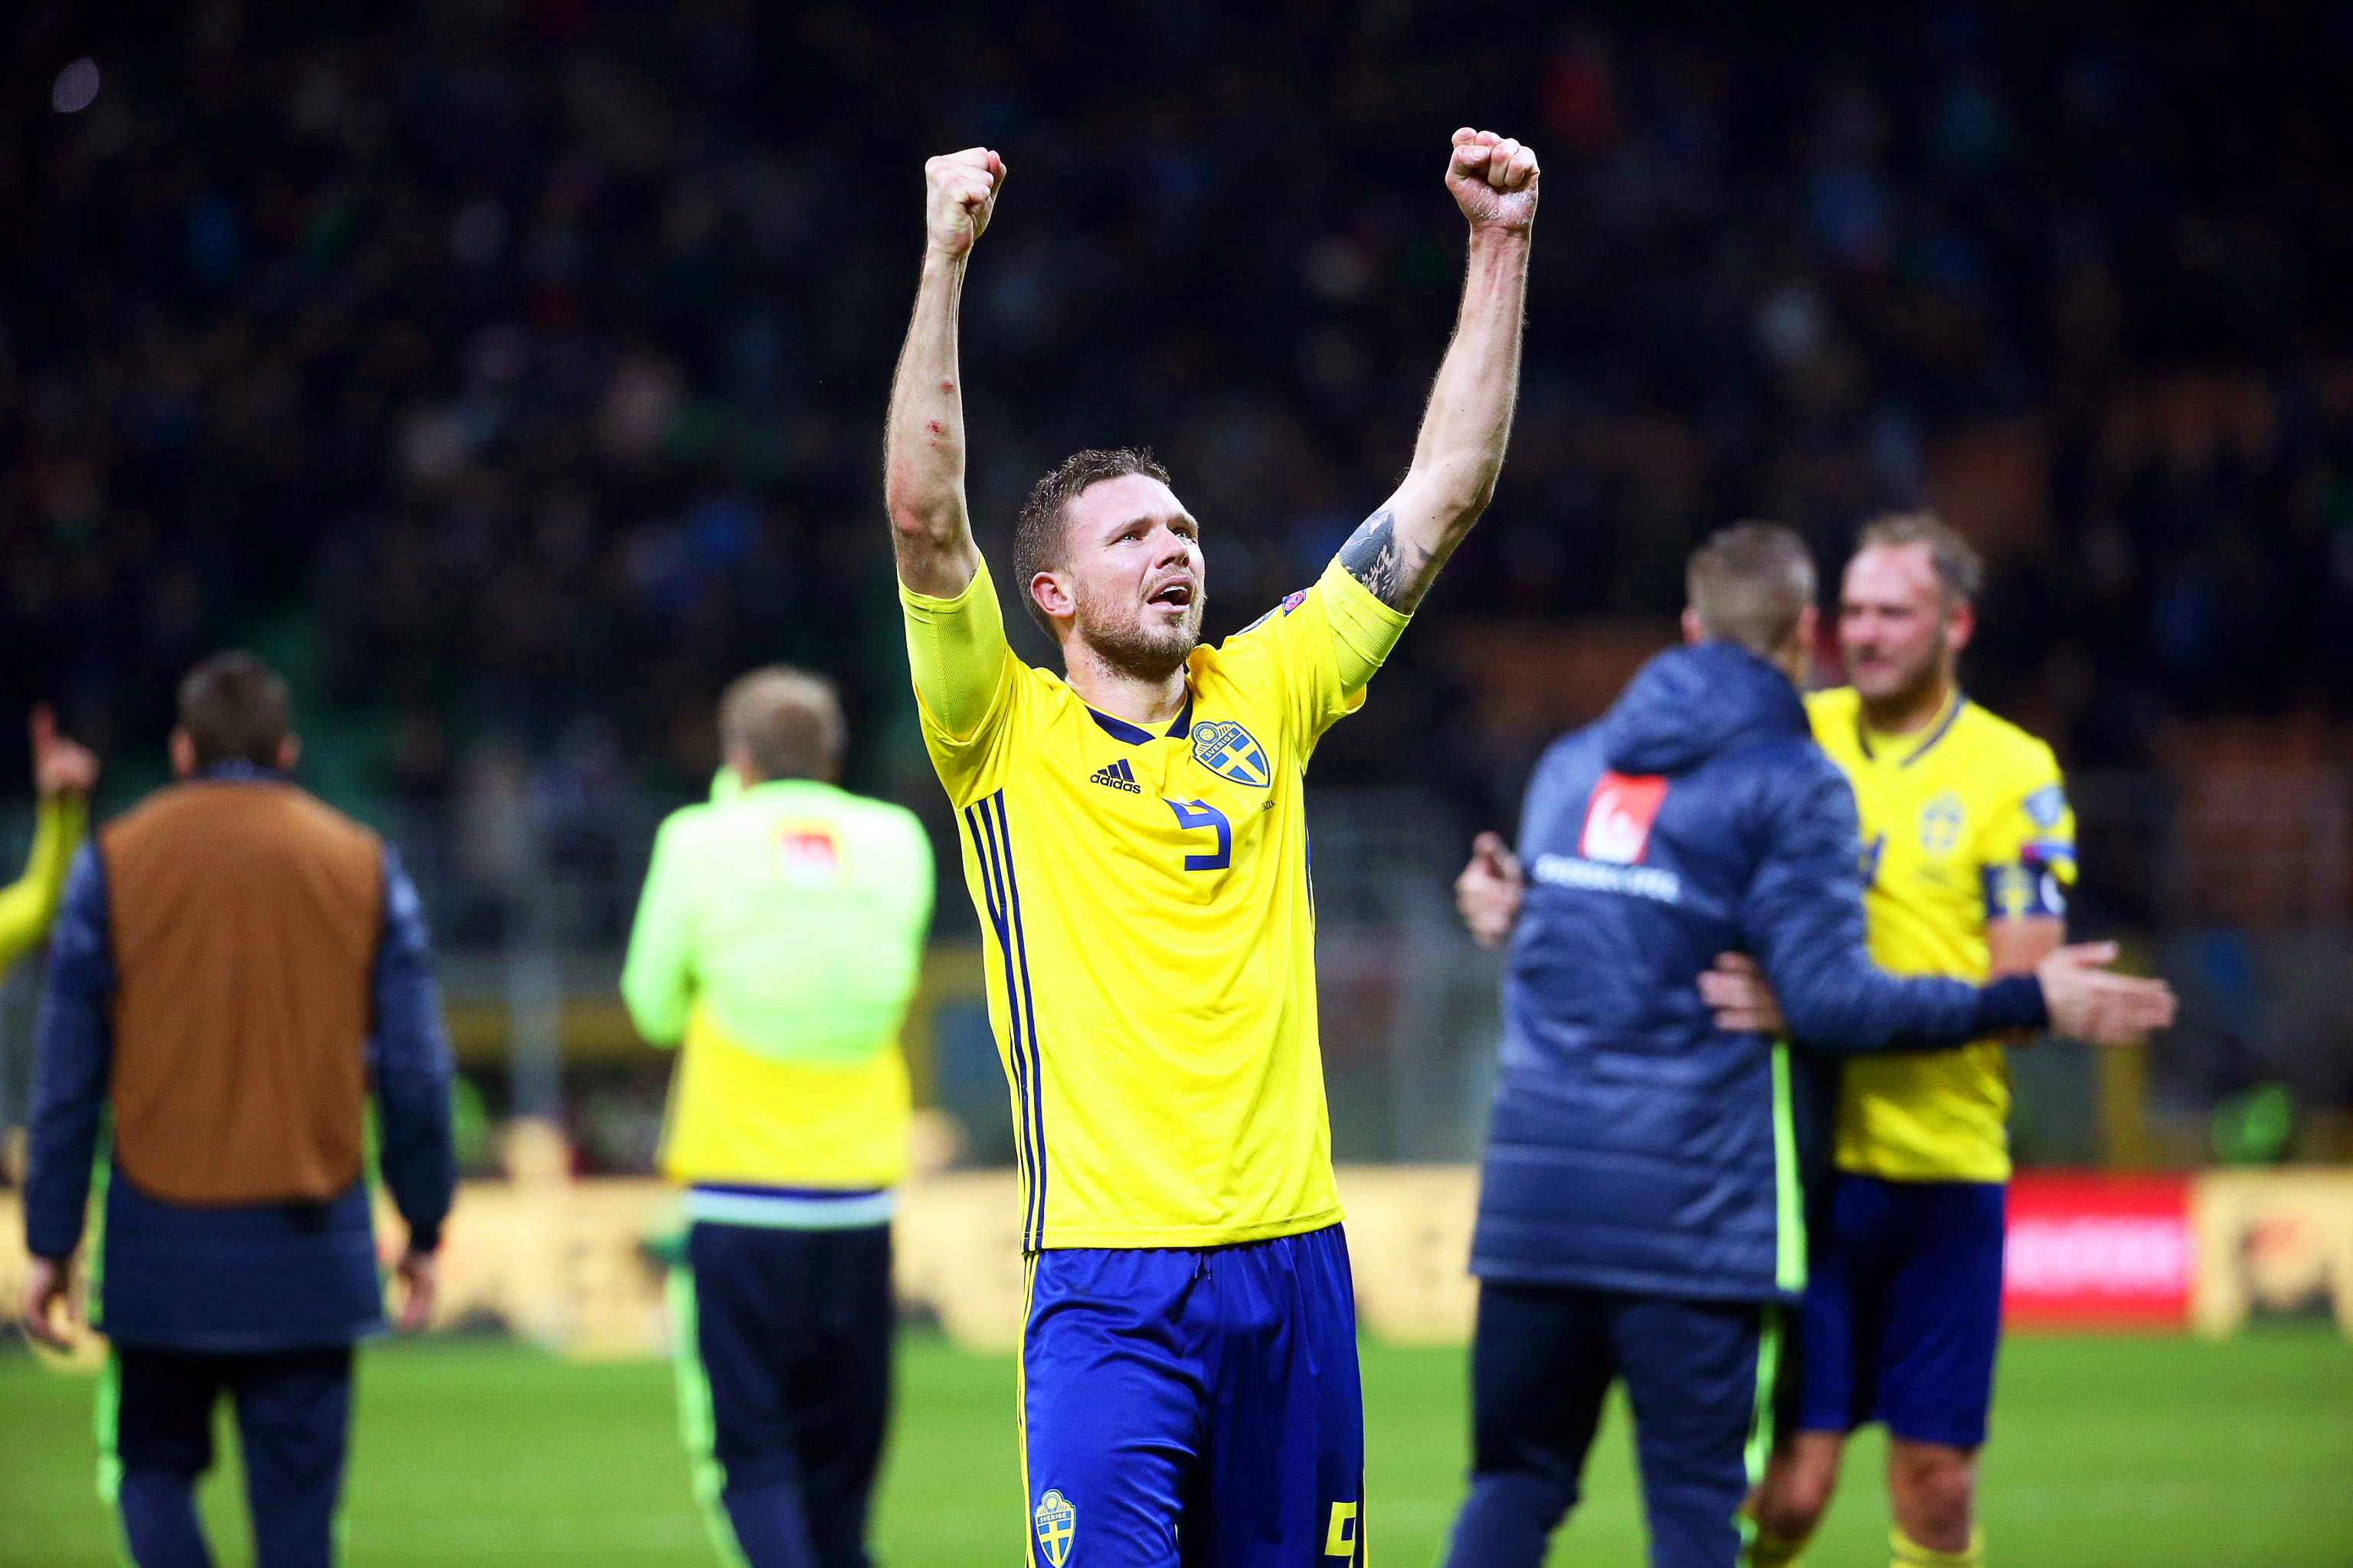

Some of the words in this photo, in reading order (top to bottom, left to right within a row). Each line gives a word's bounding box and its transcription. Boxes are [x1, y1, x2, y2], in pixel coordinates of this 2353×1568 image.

[1205, 732, 1235, 758] SVERIGE
[1090, 774, 1141, 794] adidas
[1039, 1512, 1067, 1524] SVERIGE
